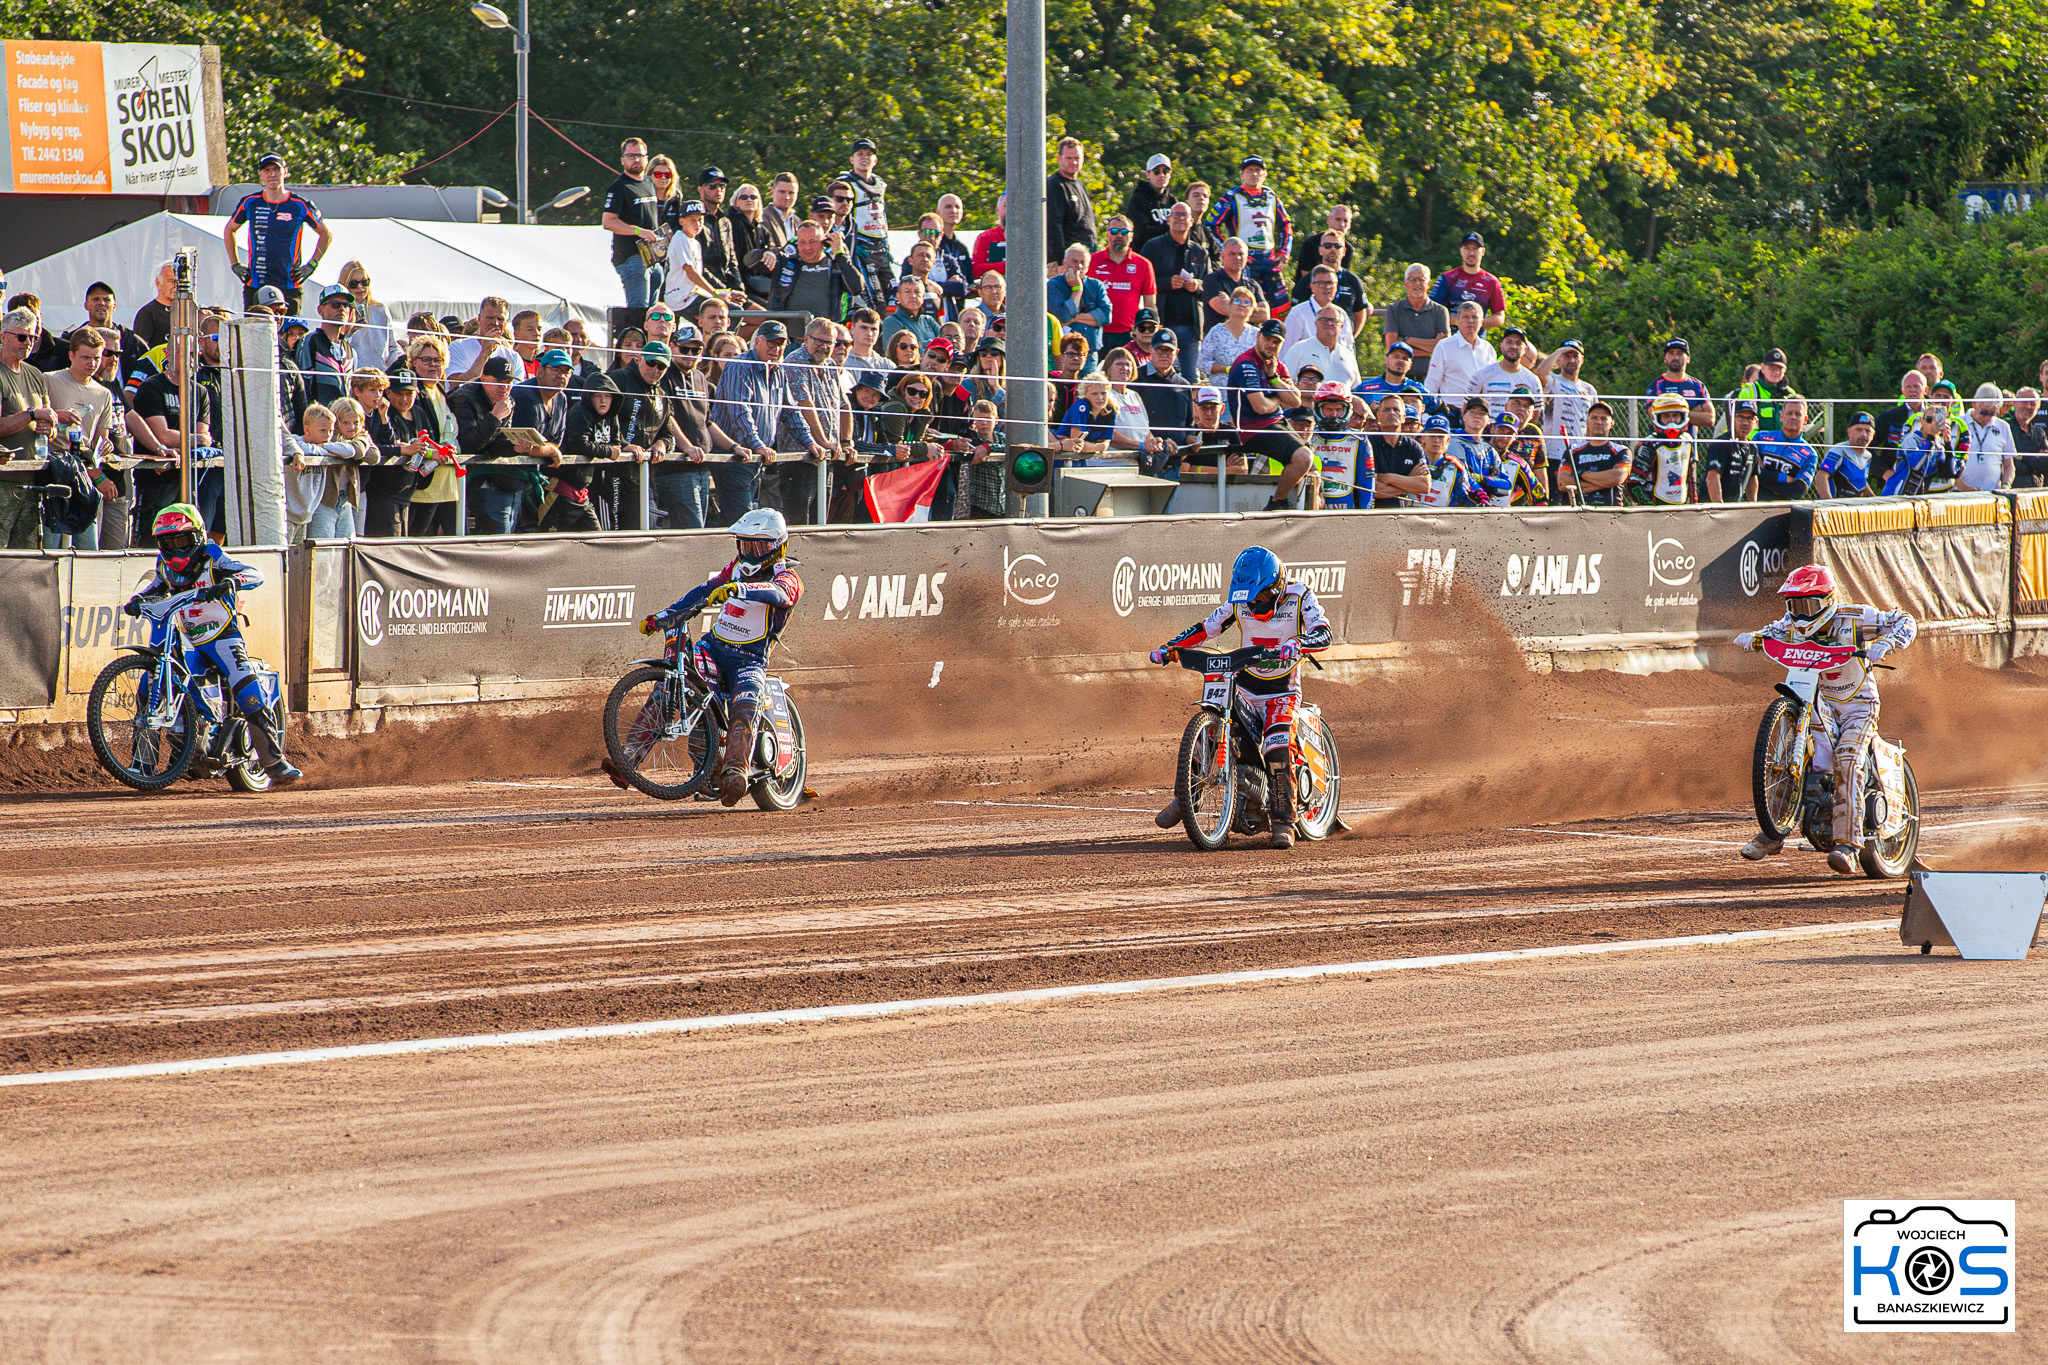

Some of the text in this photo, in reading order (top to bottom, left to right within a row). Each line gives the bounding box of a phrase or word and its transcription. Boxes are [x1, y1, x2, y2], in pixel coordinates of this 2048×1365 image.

[16, 50, 75, 69] Støbearbejde
[17, 75, 78, 93] Facade og tag
[114, 69, 188, 91] MURER MESTER
[19, 98, 88, 117] Fliser og klinker
[116, 84, 192, 125] SØREN
[20, 122, 82, 141] Nybyg og rep.
[121, 119, 195, 168] SKOU
[22, 147, 84, 162] Tlf. 2442 1340
[20, 171, 107, 186] muremesterskou.dk
[125, 172, 139, 186] Når
[140, 171, 158, 184] hver
[1138, 562, 1222, 592] KOOPMANN
[1529, 553, 1603, 595] ANLAS
[388, 587, 490, 619] KOOPMANN
[858, 572, 948, 619] ANLAS
[1233, 591, 1247, 600] KJH
[543, 591, 636, 622] FIM-MOTO.TV
[61, 606, 146, 649] SUPER
[388, 621, 487, 636] ENERGIE- UND ELEKTROTECHNIK
[1209, 659, 1228, 669] KJH
[1782, 647, 1832, 663] ENGEL
[1206, 688, 1227, 700] 842
